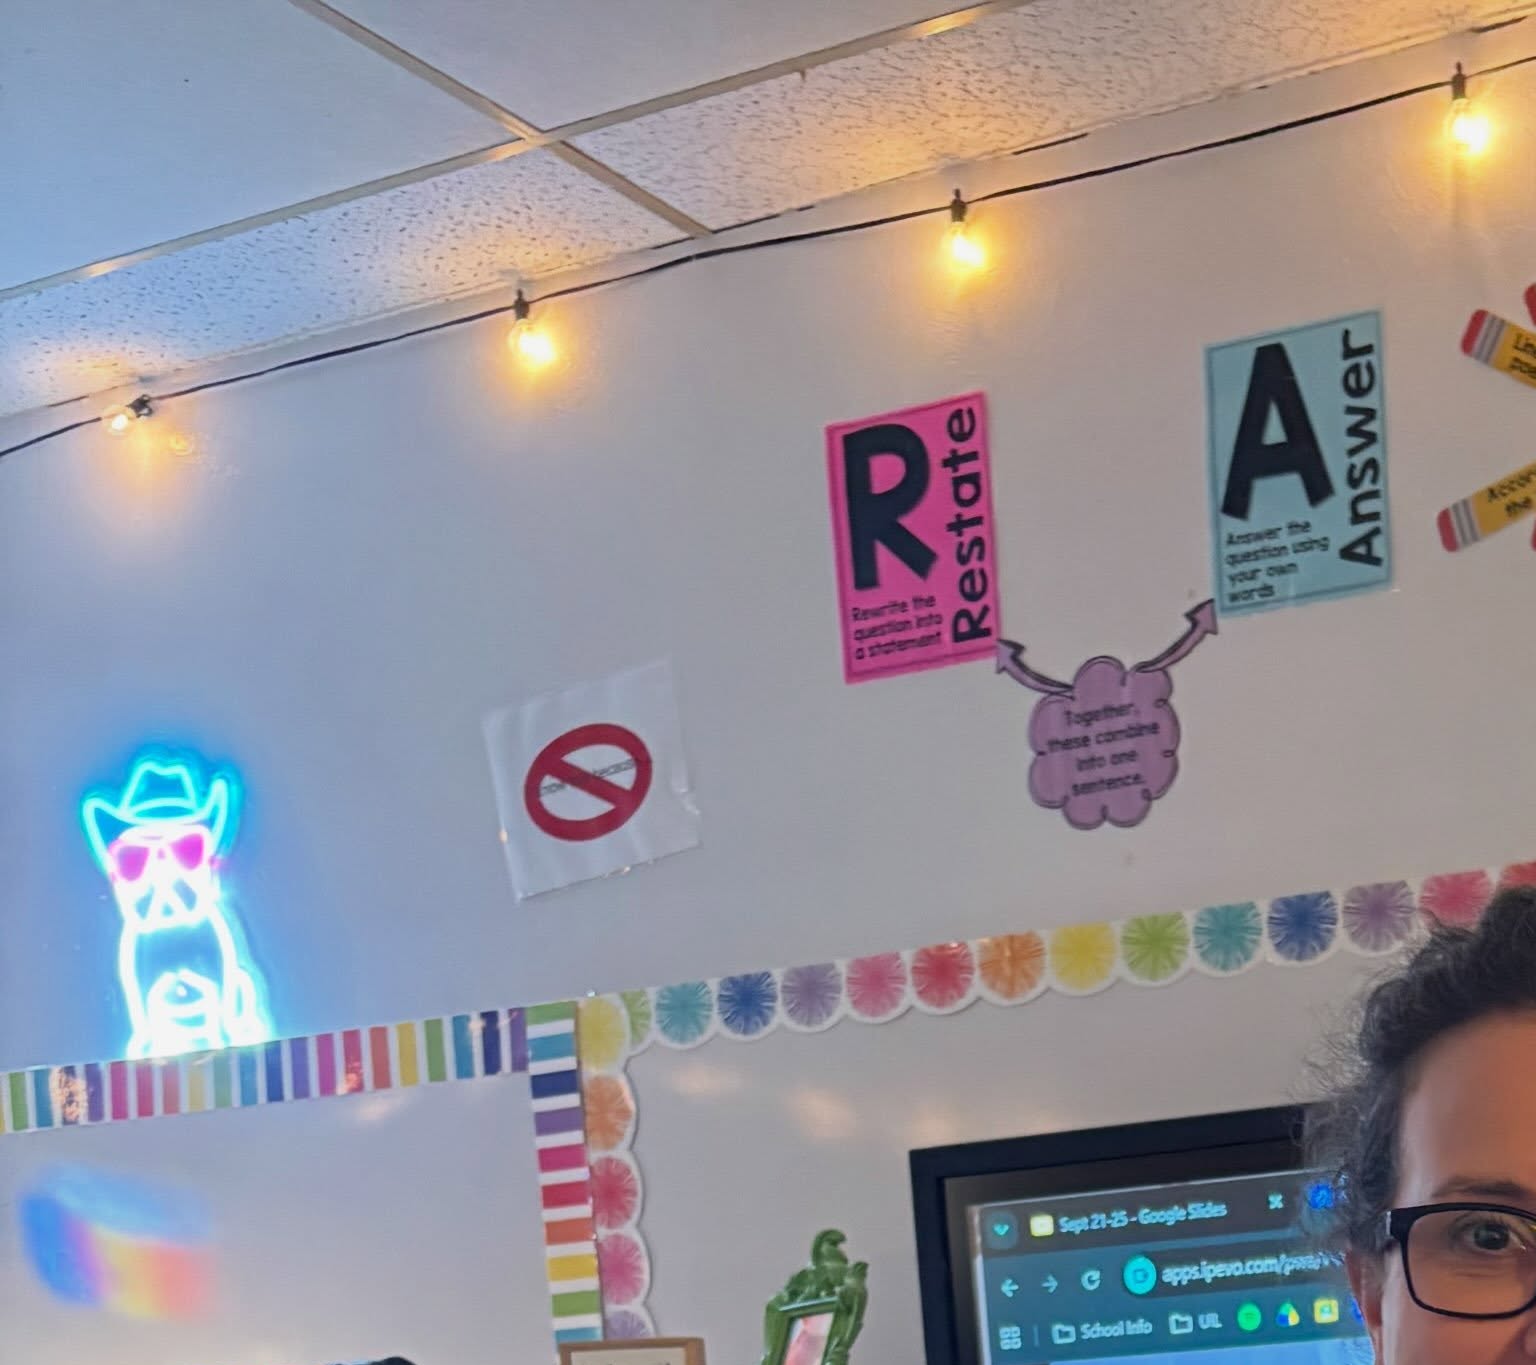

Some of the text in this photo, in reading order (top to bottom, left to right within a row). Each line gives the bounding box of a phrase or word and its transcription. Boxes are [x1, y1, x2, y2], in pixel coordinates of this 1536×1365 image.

[842, 424, 938, 591] R
[1220, 343, 1335, 521] A
[1339, 328, 1383, 567] Answer
[942, 407, 992, 643] Restate
[1058, 1216, 1089, 1235] Sept
[1137, 1205, 1187, 1226] Google
[1187, 1201, 1228, 1220] Slides
[1080, 1318, 1152, 1340] School Info
